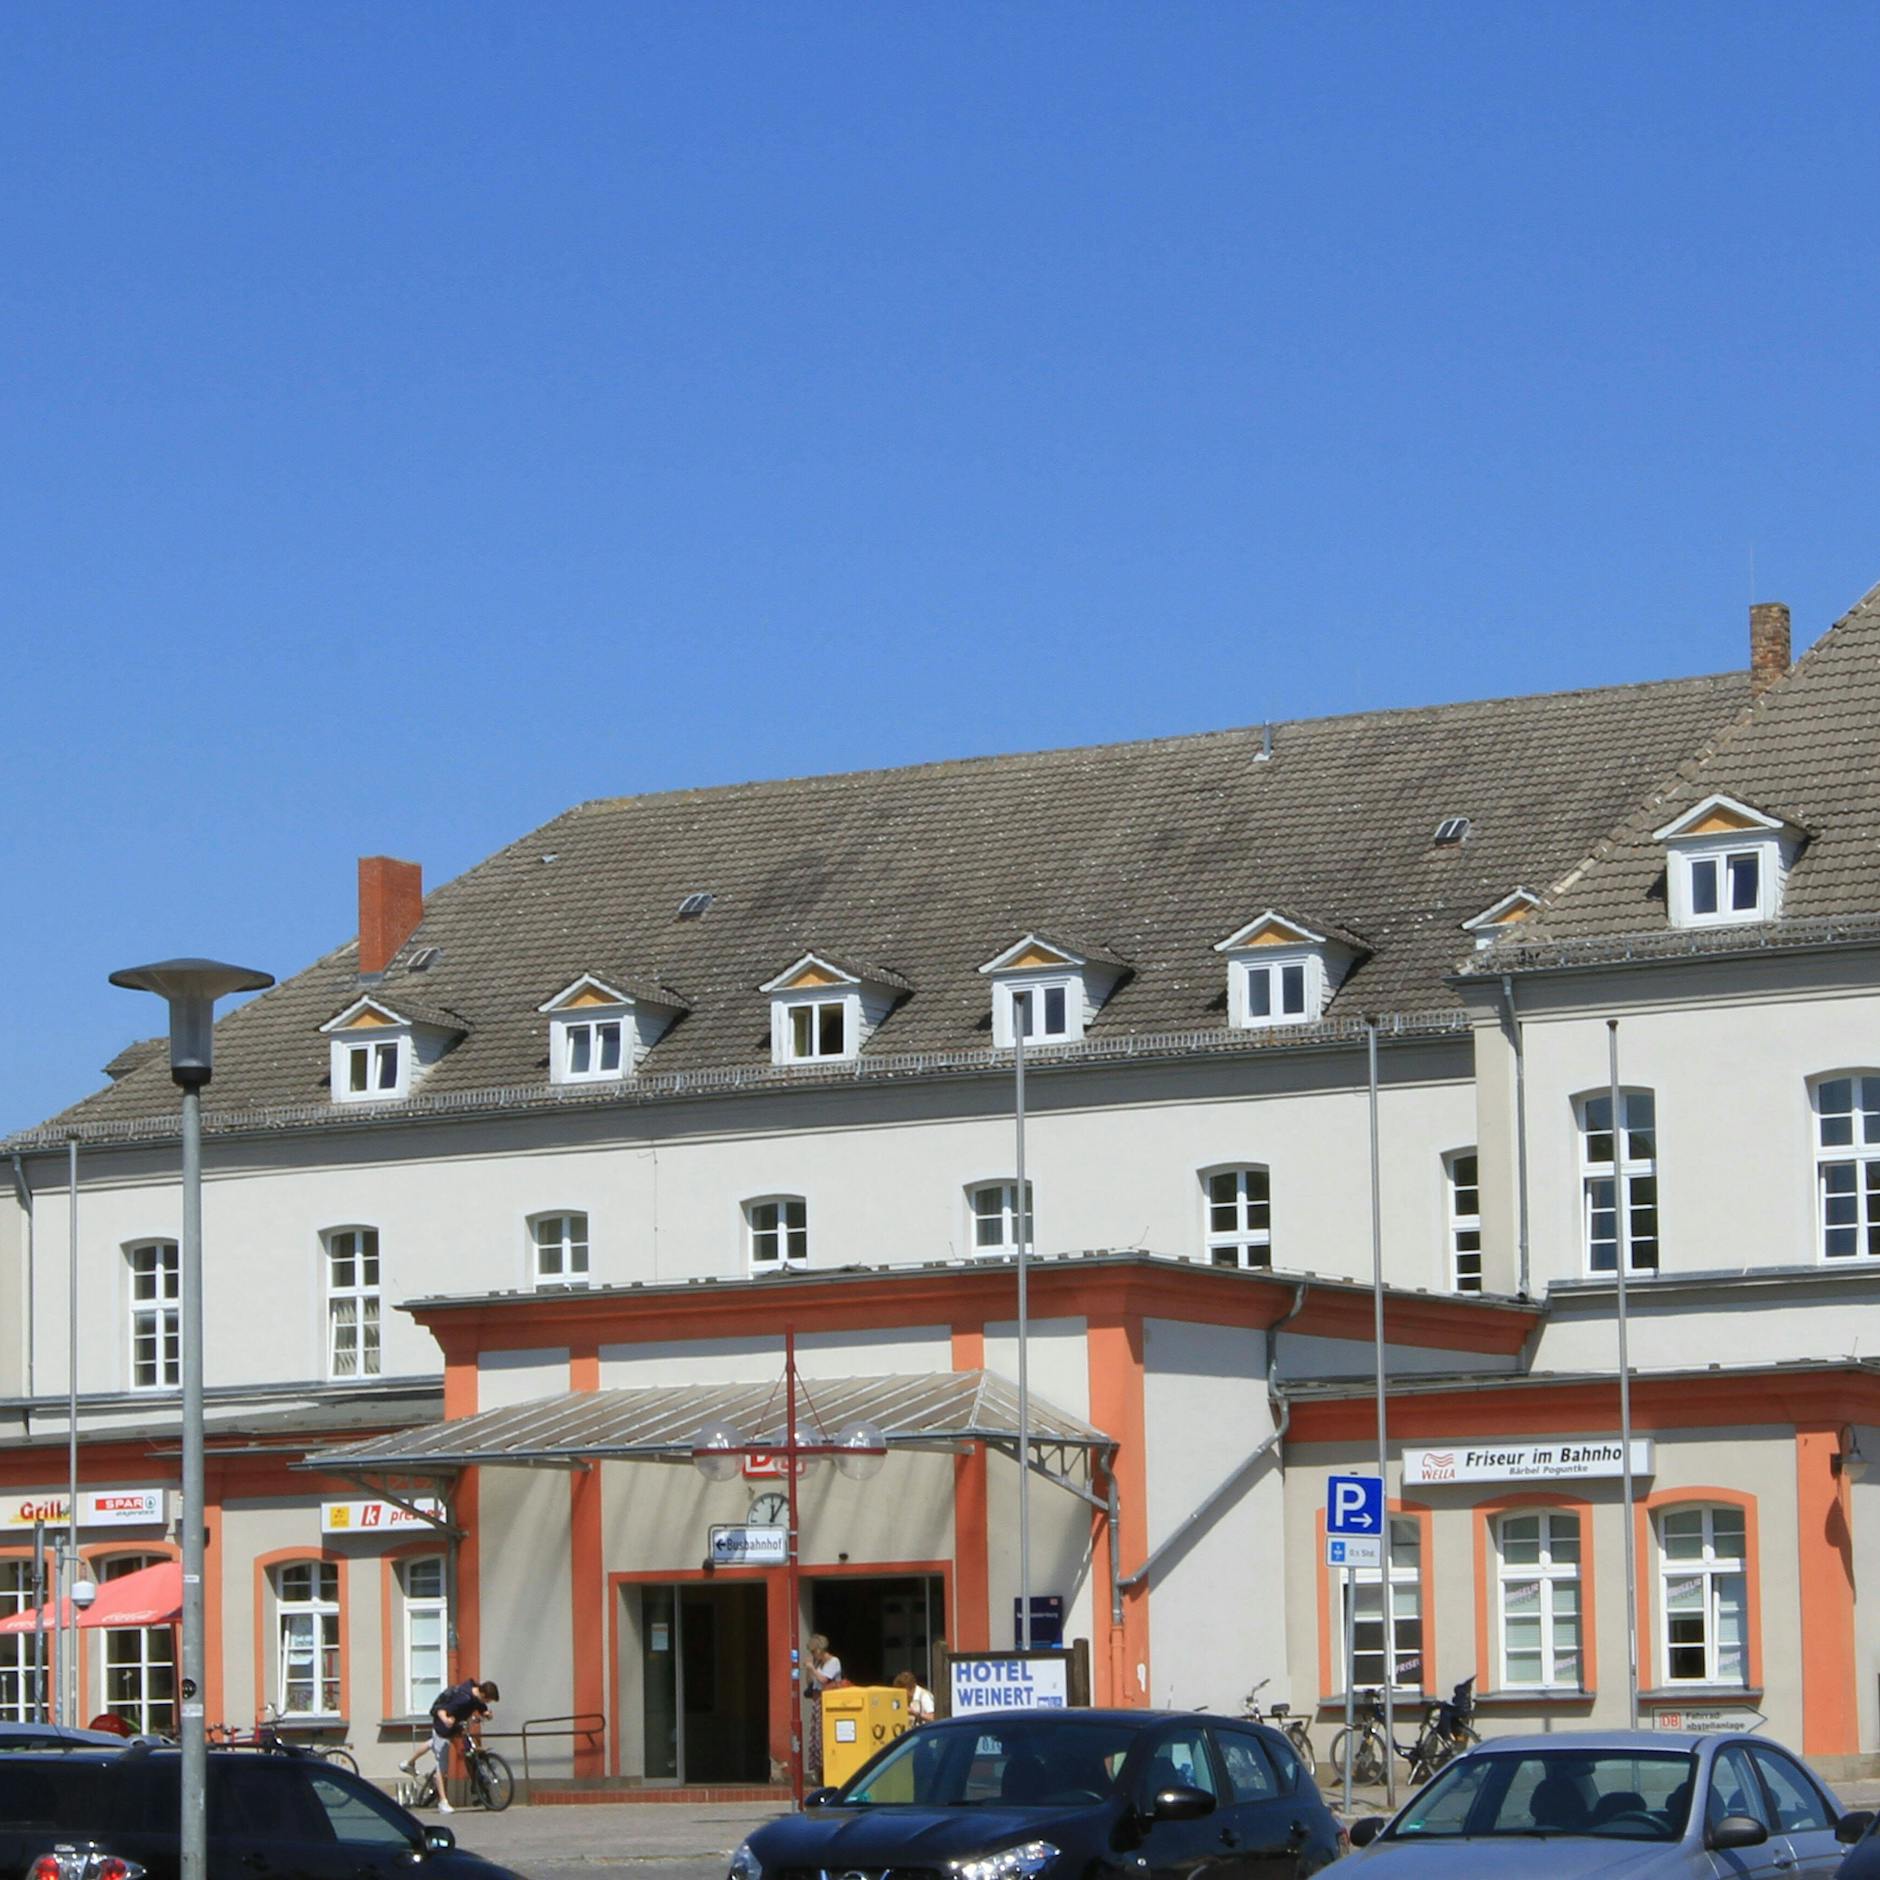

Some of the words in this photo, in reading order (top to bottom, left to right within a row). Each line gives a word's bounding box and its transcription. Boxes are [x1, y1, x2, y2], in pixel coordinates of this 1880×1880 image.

[1466, 1450, 1525, 1467] Friseur
[1532, 1448, 1552, 1464] im
[1560, 1446, 1624, 1463] Bahnho
[1421, 1467, 1456, 1480] WELLA
[1509, 1466, 1540, 1476] Bärbel
[1543, 1464, 1588, 1475] Poguntke
[19, 1500, 63, 1521] Grill
[104, 1497, 144, 1510] SPAR
[1335, 1482, 1367, 1528] P
[364, 1506, 377, 1526] k
[726, 1538, 783, 1552] Busbahnhof
[956, 1660, 1034, 1683] HOTEL
[957, 1687, 1034, 1707] WEINERT
[1661, 1712, 1680, 1727] DB
